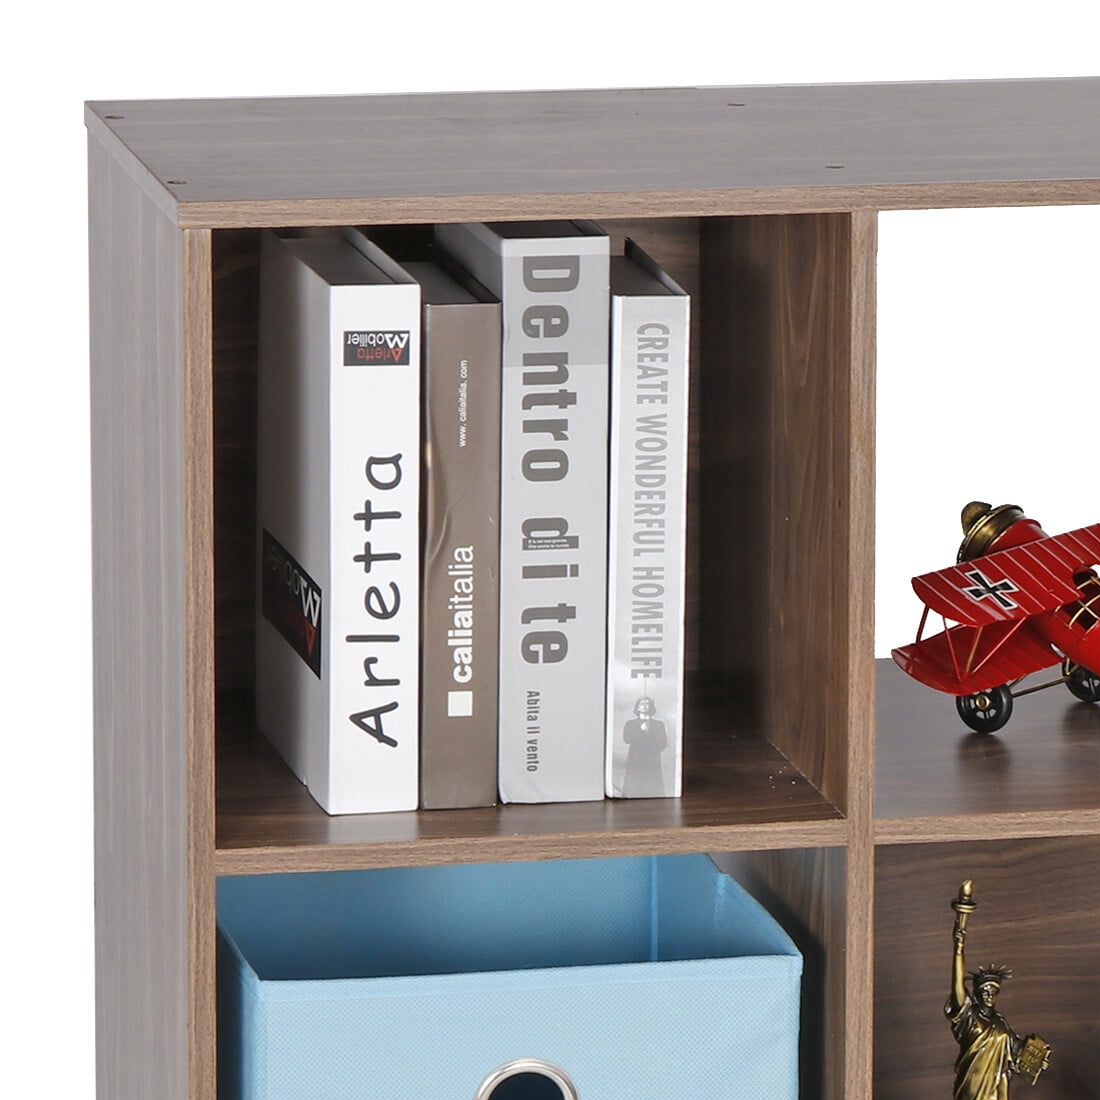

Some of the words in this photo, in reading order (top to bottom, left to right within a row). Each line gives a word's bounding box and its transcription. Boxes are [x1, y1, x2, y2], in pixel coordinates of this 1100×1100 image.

[357, 347, 404, 361] Arletta
[522, 255, 580, 482] Dentro
[636, 322, 670, 405] CREATE
[632, 413, 668, 557] WONDERFUL
[521, 517, 579, 579] di
[345, 453, 402, 748] Arletta
[448, 545, 473, 683] caliaitalia
[521, 603, 576, 664] te
[630, 566, 665, 679] HOMELIFE
[526, 690, 540, 721] Abita
[526, 739, 539, 772] vento
